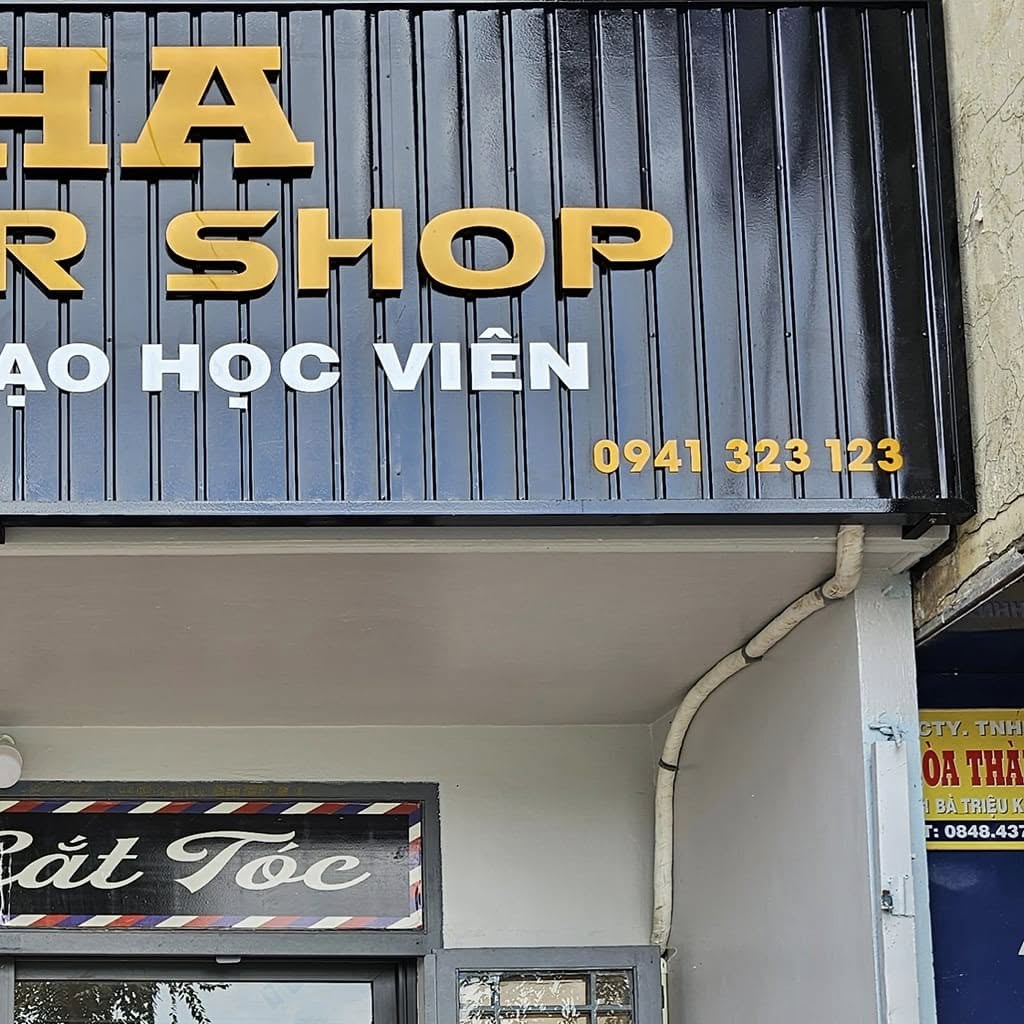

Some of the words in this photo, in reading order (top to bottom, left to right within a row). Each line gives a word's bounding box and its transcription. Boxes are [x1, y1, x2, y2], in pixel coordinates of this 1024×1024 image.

[165, 206, 675, 293] SHOP
[141, 342, 341, 409] HỌC
[373, 327, 591, 392] VIÊN
[593, 439, 703, 473] 0941
[725, 438, 811, 473] 323
[825, 437, 905, 473] 123
[919, 720, 969, 737] CTY.
[965, 740, 1024, 787] THÀ
[936, 794, 959, 815] BÀ
[961, 794, 1009, 819] TRIỆU
[166, 830, 371, 895] Tóc
